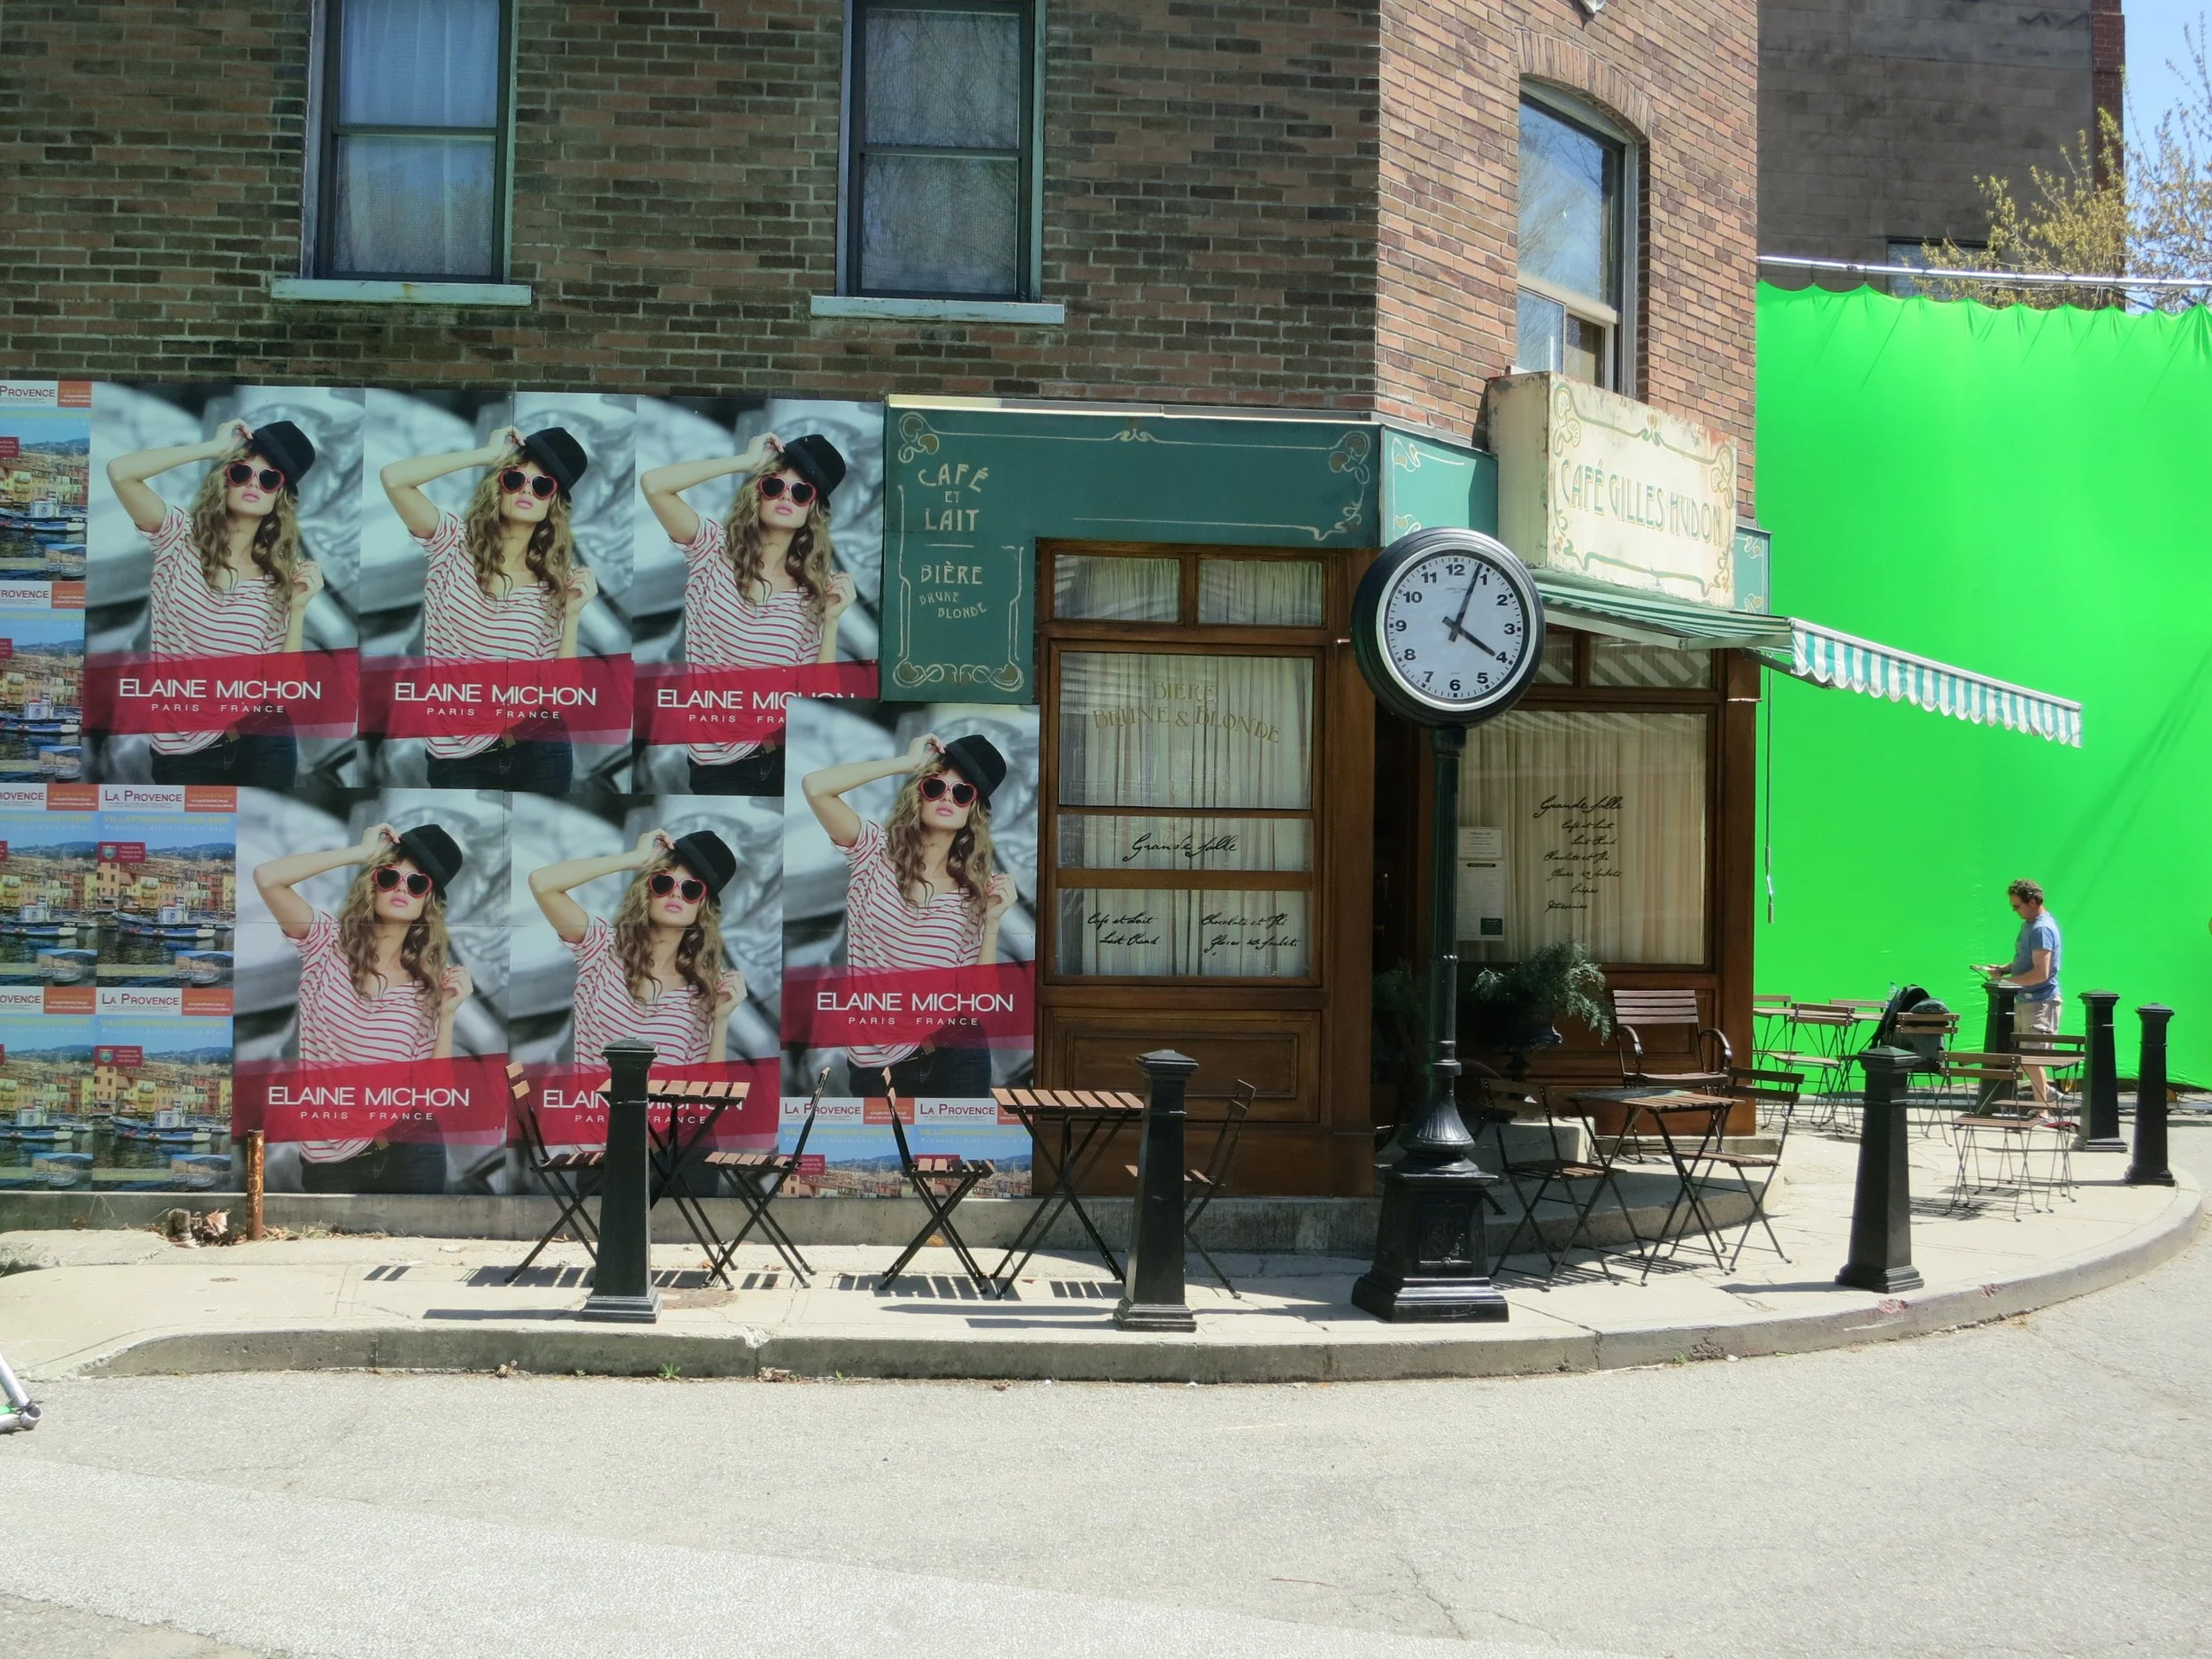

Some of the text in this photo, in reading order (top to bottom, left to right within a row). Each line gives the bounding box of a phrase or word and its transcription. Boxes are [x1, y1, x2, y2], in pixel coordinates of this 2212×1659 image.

[918, 464, 988, 493] CAFÉ
[945, 491, 961, 503] ET
[1562, 458, 1605, 516] CAFÉ
[1609, 474, 1665, 532] GILLES
[925, 508, 979, 531] LAIT
[920, 560, 983, 584] BIÈRE
[1446, 564, 1465, 576] 12
[1421, 572, 1438, 584] 11
[1480, 573, 1487, 585] 1
[0, 589, 49, 599] ROVENCE
[919, 591, 959, 605] BRUNE
[1402, 591, 1423, 603] 10
[1496, 594, 1509, 606] 2
[938, 602, 987, 619] BLONDE
[1394, 619, 1407, 632] 9
[1503, 623, 1516, 635] 3
[1403, 649, 1416, 660] 8
[1495, 651, 1508, 664] 4
[1423, 671, 1434, 682] 7
[1477, 672, 1488, 684] 5
[119, 678, 321, 700] ELAINE MICHON
[1449, 679, 1461, 691] 6
[395, 682, 596, 706] ELAINE MICHON
[657, 688, 855, 710] ELAINE MIC
[151, 703, 284, 713] PARIS FRANCE
[496, 709, 560, 719] FRANCE
[1093, 705, 1281, 743] BRUNE & BLONDE
[0, 792, 44, 801] OVENCE
[1122, 833, 1192, 862] Grande
[0, 995, 42, 1004] OVENCE
[817, 992, 1013, 1012] ELAINE MICHON
[268, 1086, 470, 1107] ELAINE MICHON
[543, 1089, 611, 1109] ELAIN
[369, 1111, 433, 1120] FRANCE
